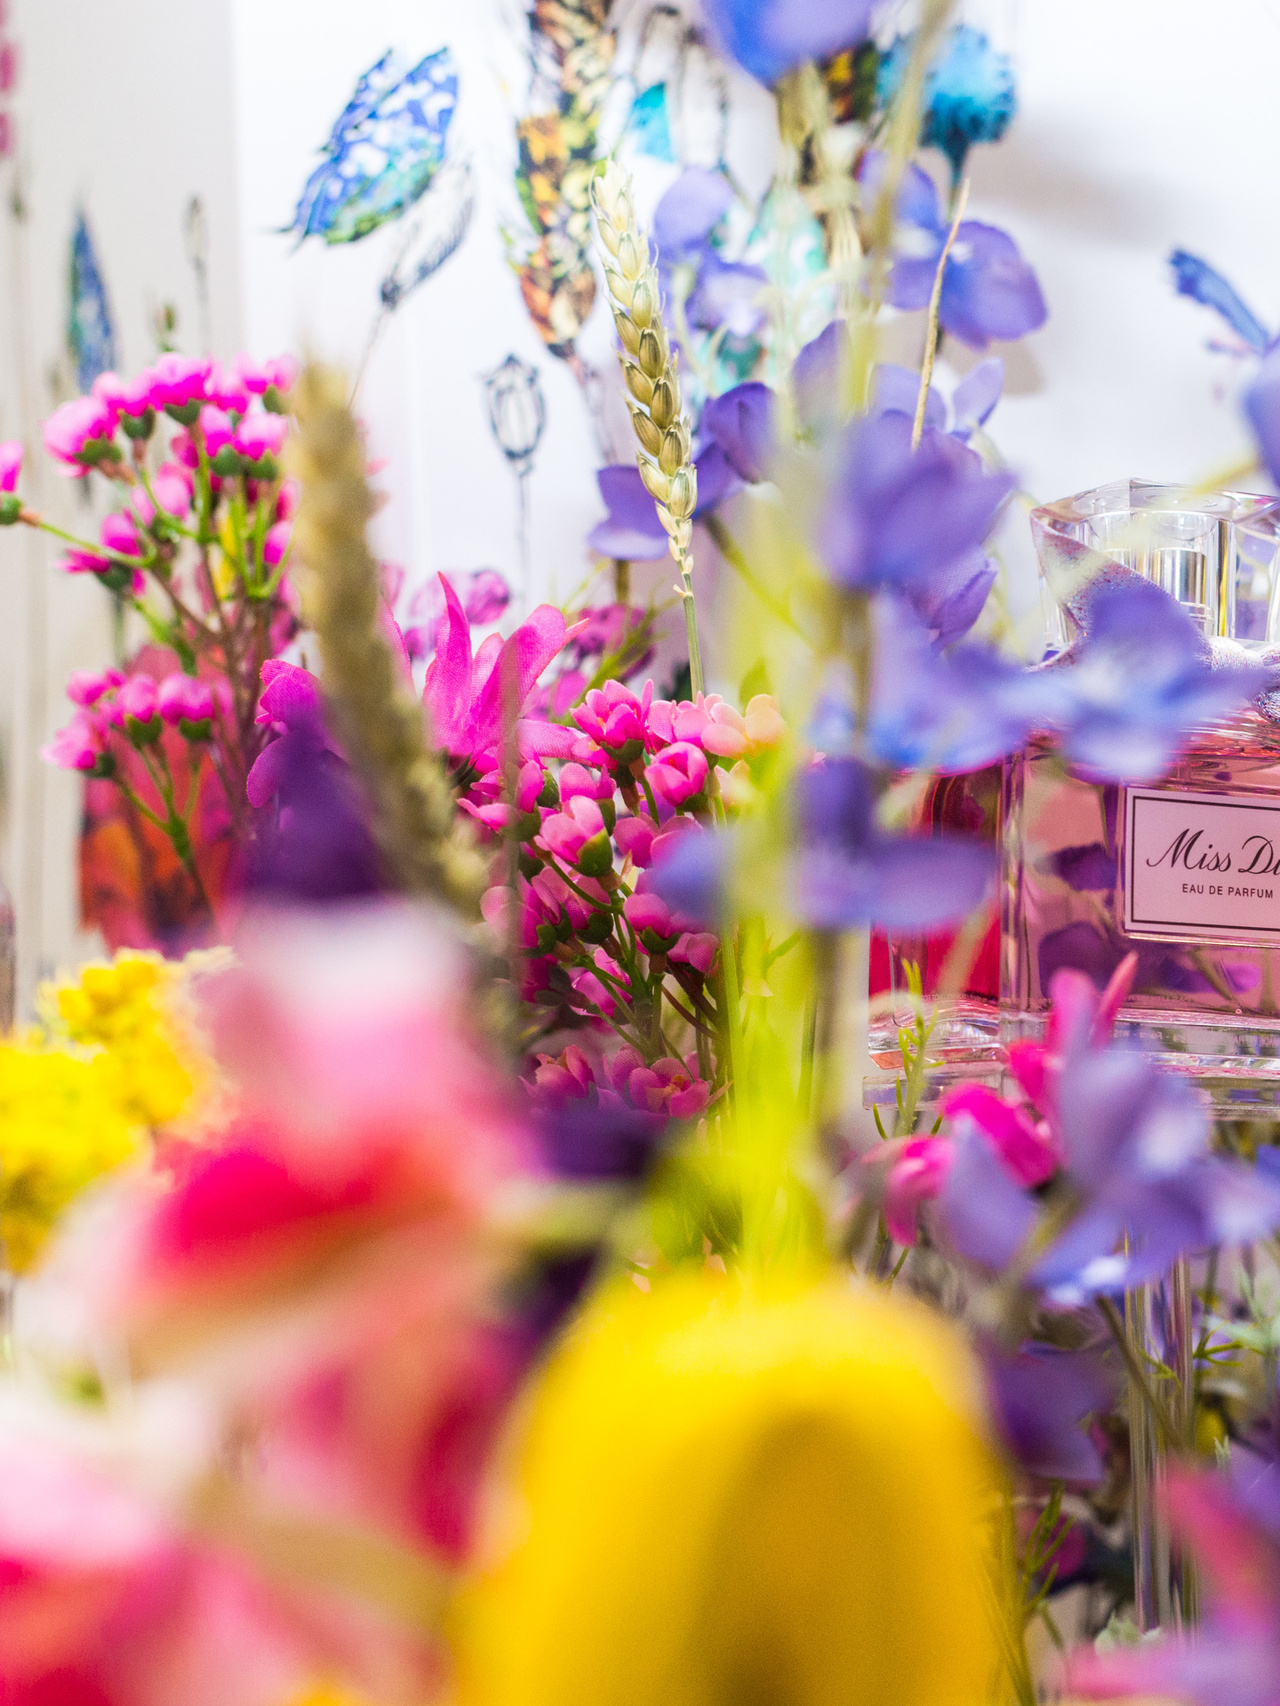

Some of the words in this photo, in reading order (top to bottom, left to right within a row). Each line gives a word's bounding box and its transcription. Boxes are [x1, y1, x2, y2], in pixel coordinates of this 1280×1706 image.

[1146, 828, 1232, 872] Miss
[1182, 883, 1204, 894] EAU
[1209, 885, 1223, 895] DE
[1227, 887, 1273, 899] PARFUM
